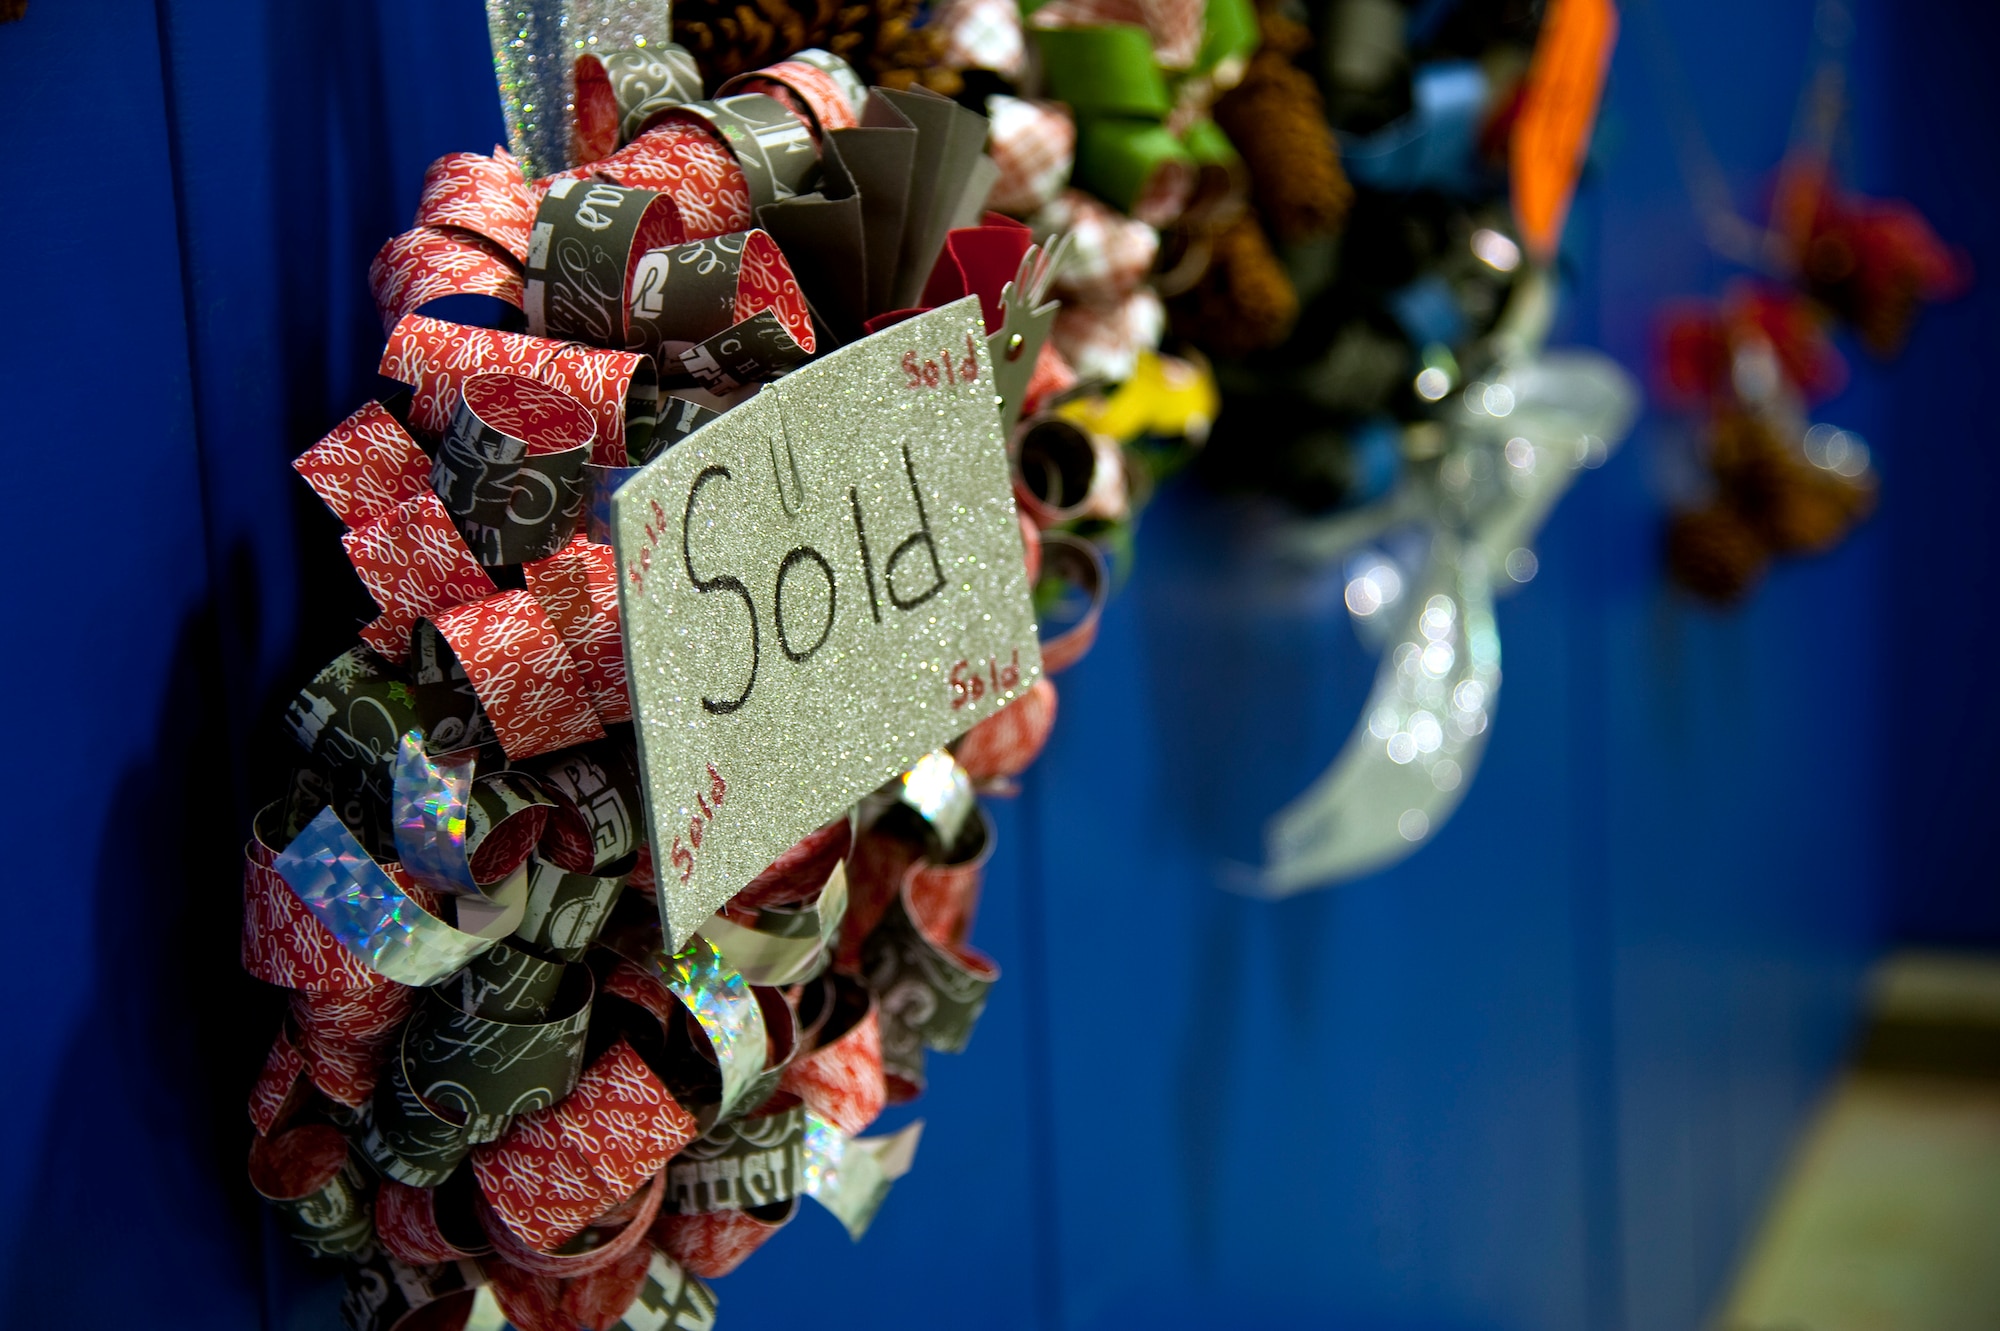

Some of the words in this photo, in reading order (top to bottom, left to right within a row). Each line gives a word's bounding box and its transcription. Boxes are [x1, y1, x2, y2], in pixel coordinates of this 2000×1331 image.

[902, 332, 979, 390] Sold
[629, 499, 667, 597] Sold
[683, 442, 947, 714] Sold
[951, 648, 1019, 711] Sold
[671, 761, 727, 886] Sold
